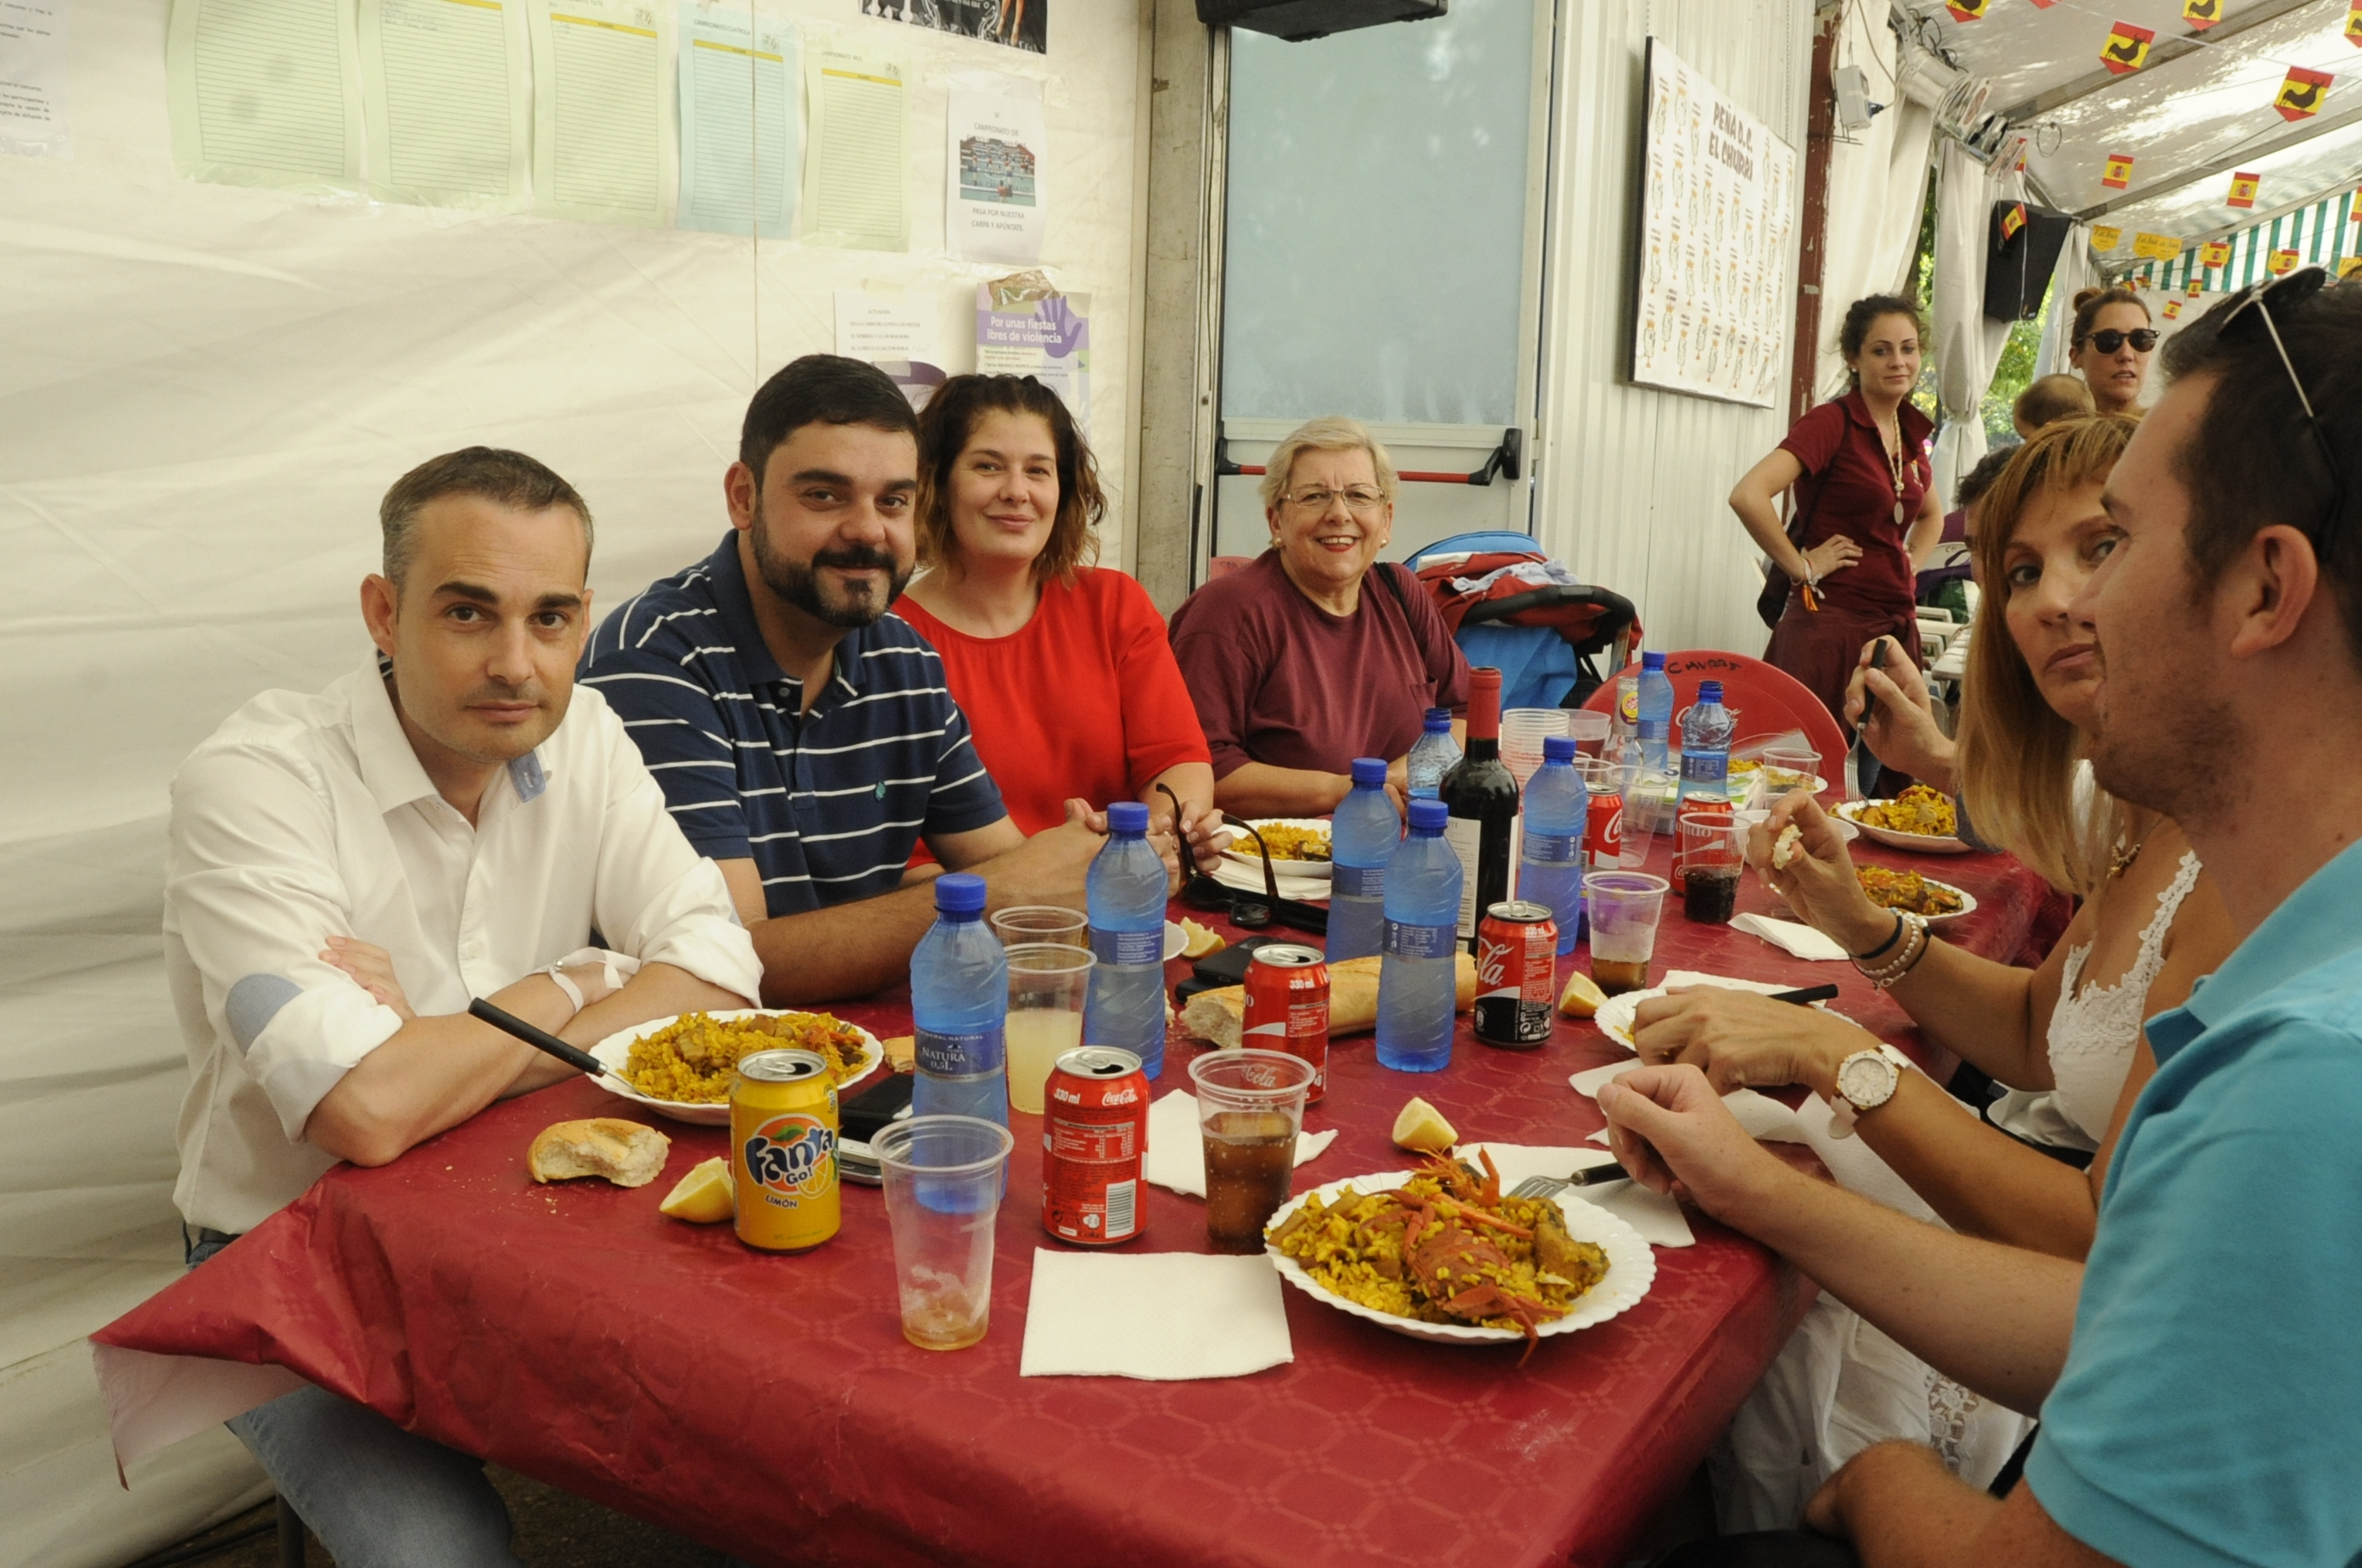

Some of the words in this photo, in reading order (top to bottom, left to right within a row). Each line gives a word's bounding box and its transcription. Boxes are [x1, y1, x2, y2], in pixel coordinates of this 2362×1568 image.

[974, 122, 1010, 136] CAMPEONATO
[1709, 130, 1719, 160] EL
[972, 207, 987, 216] PASA
[988, 209, 999, 217] POR
[999, 210, 1025, 220] NUESTRA
[971, 220, 990, 229] CARPA
[990, 316, 1005, 328] Por
[1005, 319, 1026, 329] unas
[1027, 318, 1056, 331] fiestas
[987, 328, 1007, 340] libres
[1009, 330, 1020, 342] de
[1021, 332, 1062, 344] violencia
[1289, 979, 1304, 990] 330
[1305, 979, 1315, 989] ml
[922, 1046, 966, 1063] NATURA
[1068, 1093, 1081, 1105] ml
[744, 1126, 834, 1185] Fanta
[786, 1168, 812, 1185] Go!
[765, 1194, 798, 1209] LIMÓN
